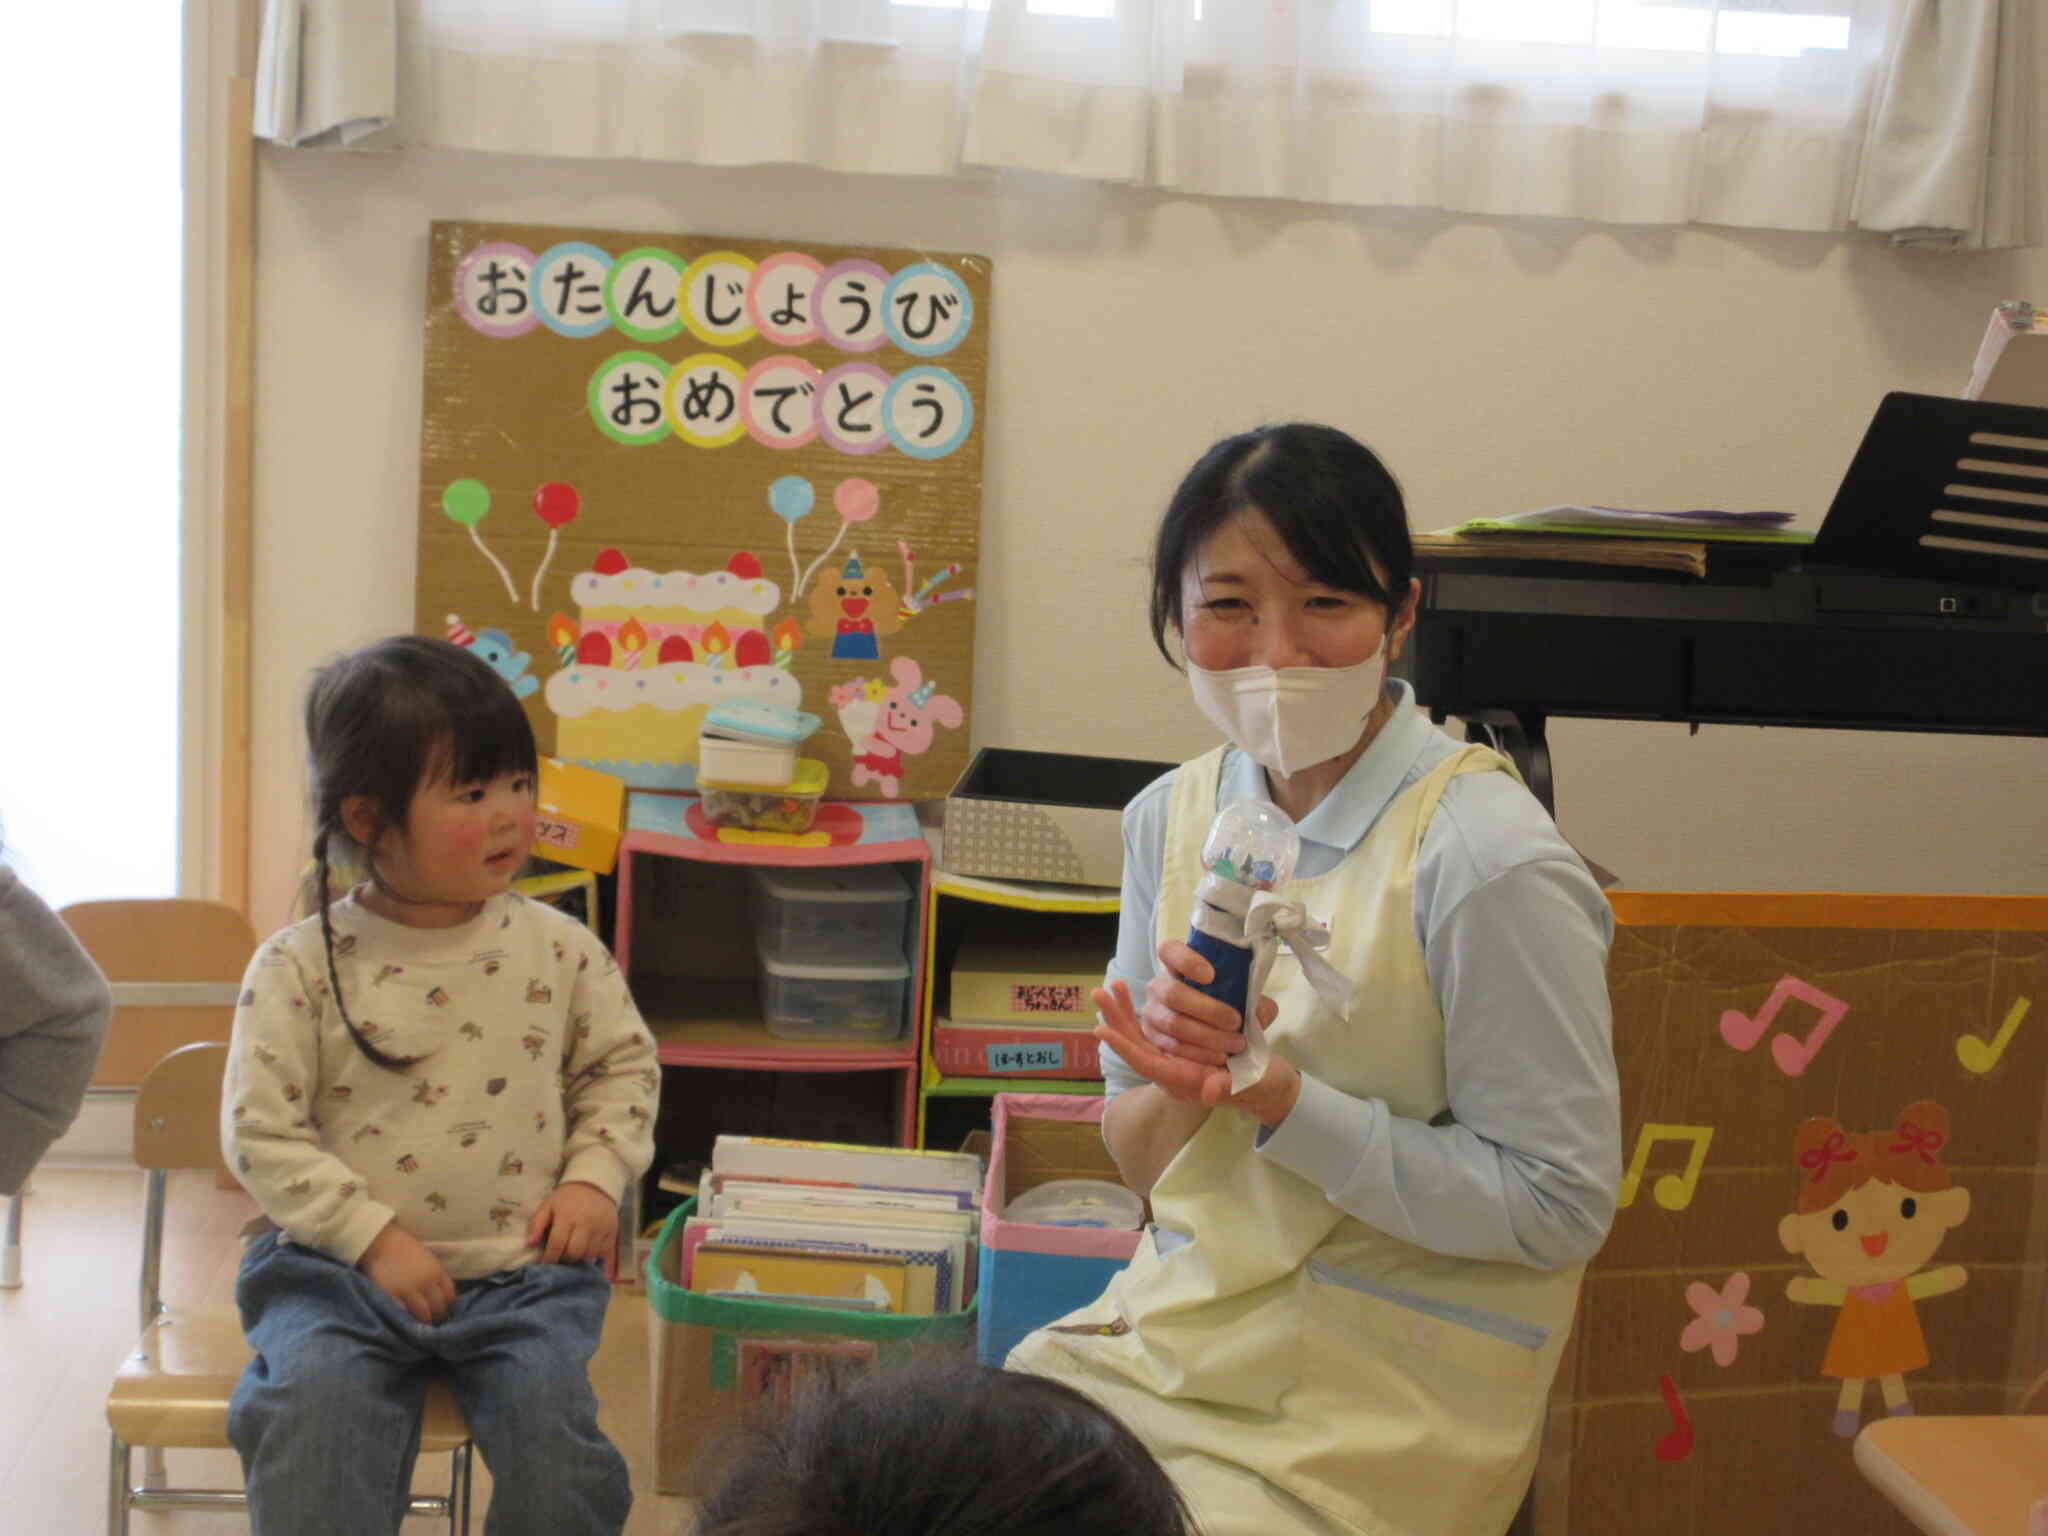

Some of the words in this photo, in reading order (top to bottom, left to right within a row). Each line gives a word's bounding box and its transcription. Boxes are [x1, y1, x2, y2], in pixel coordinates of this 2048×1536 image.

[476, 261, 959, 340] おたんじょうび
[611, 371, 943, 438] おめでとう
